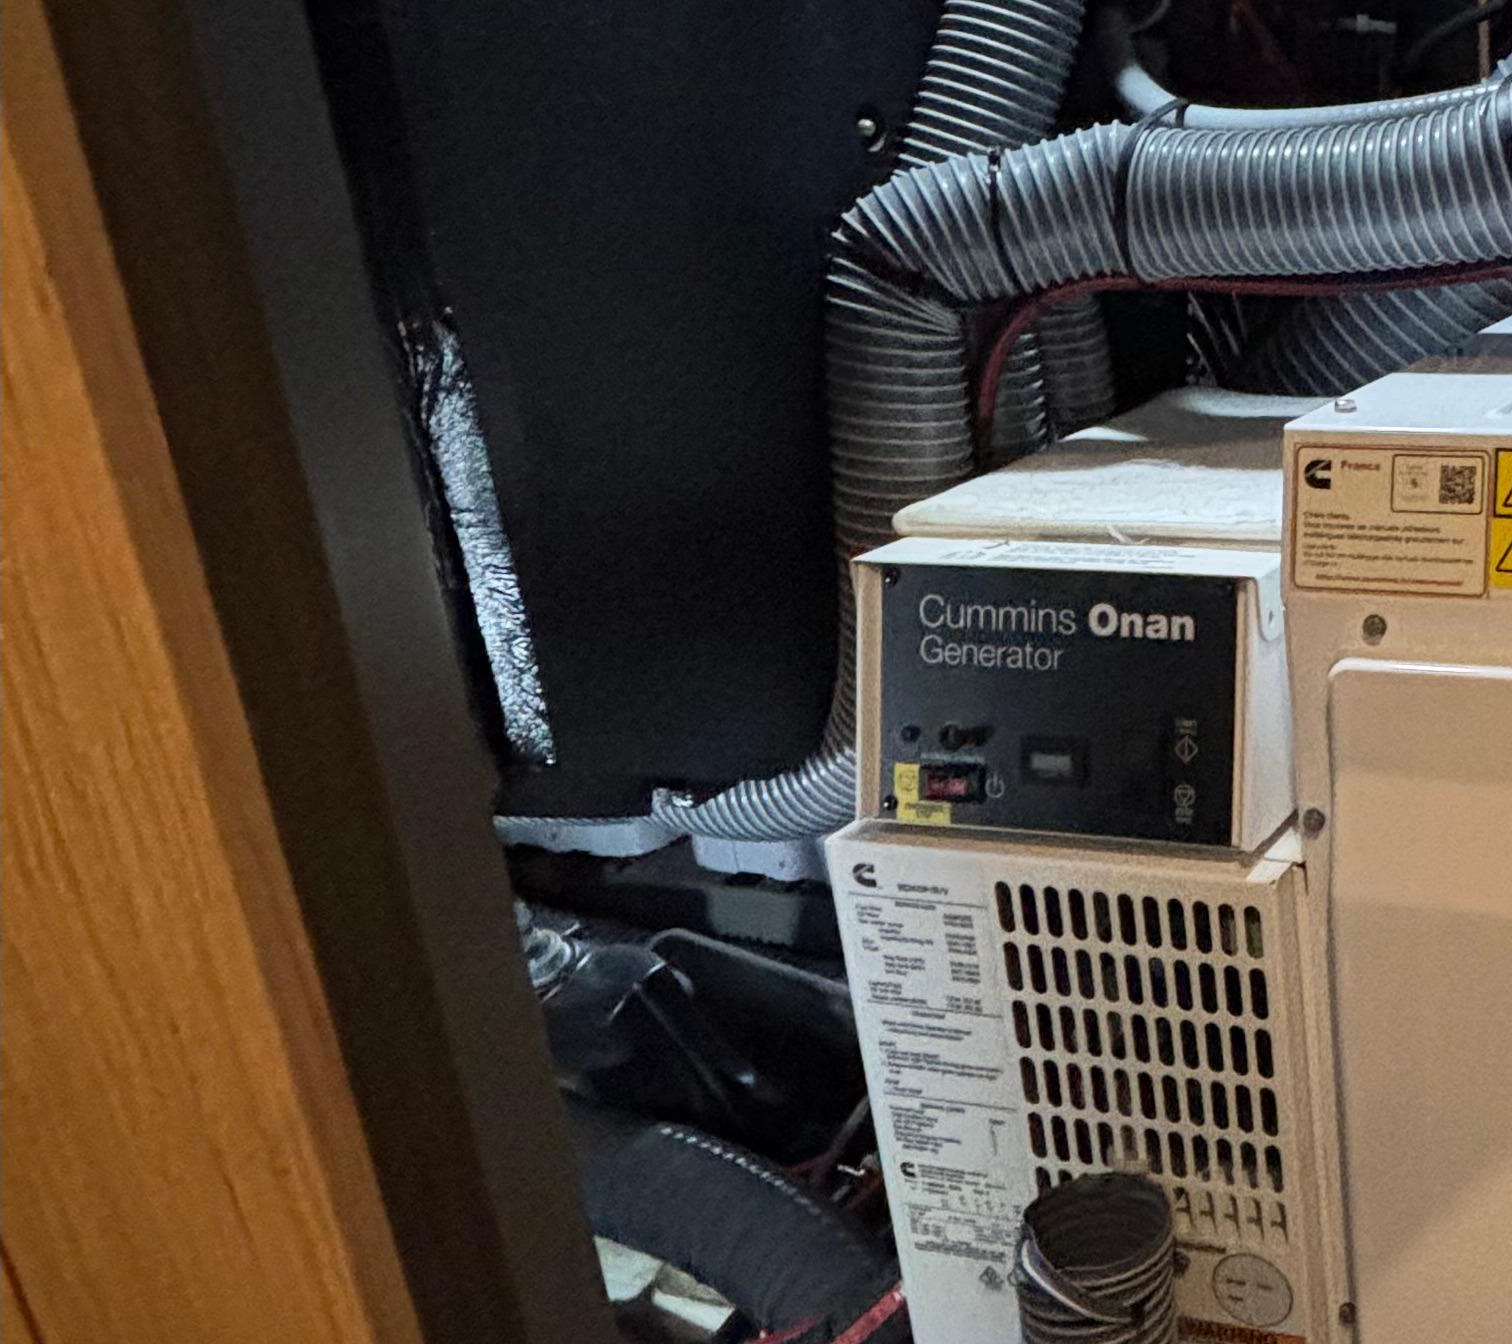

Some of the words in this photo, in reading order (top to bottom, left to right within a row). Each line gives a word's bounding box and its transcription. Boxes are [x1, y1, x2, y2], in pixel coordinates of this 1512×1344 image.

[918, 594, 1076, 635] Cummins
[1088, 603, 1195, 641] Onan
[919, 635, 1062, 671] Generator
